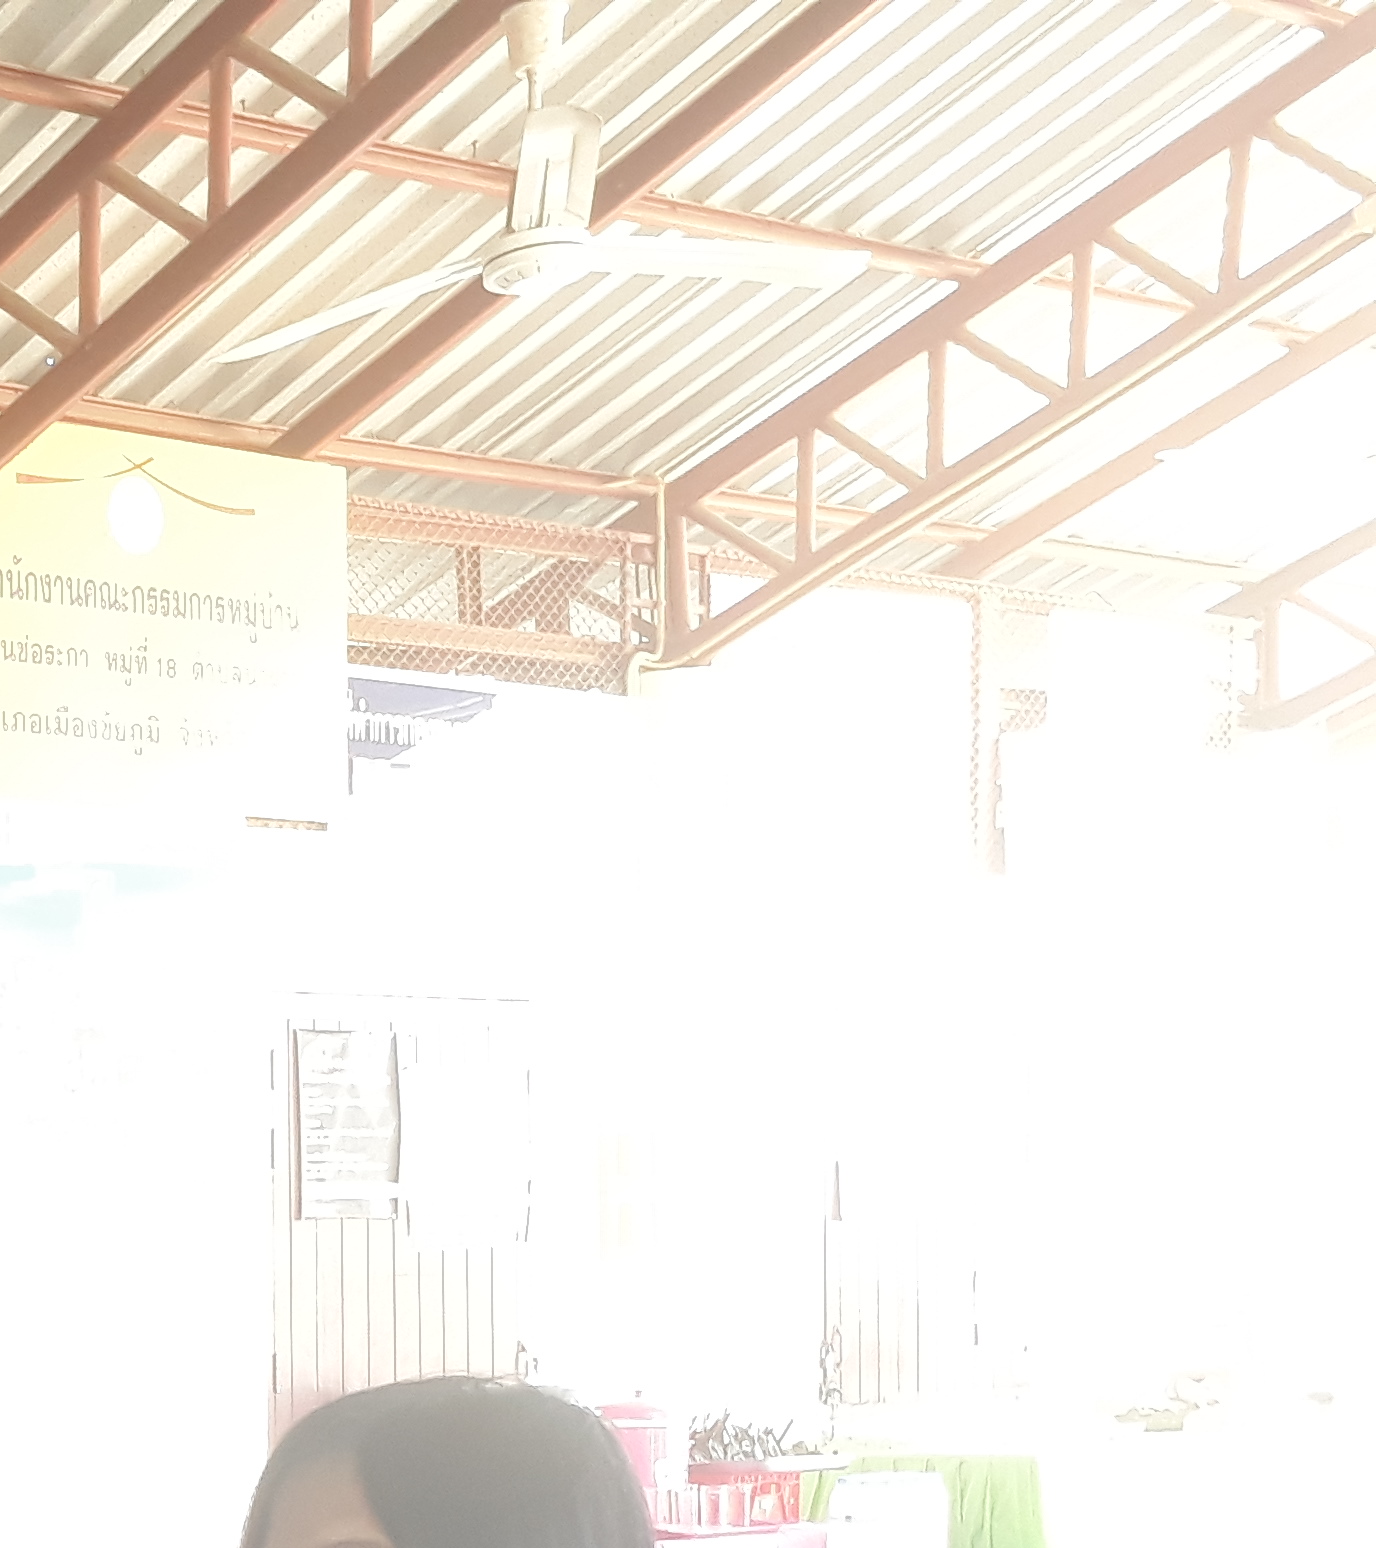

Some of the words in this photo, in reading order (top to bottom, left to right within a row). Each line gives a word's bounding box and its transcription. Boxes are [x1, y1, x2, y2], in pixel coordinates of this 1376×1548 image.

[104, 636, 148, 686] หมู่ที่
[155, 656, 178, 679] 18
